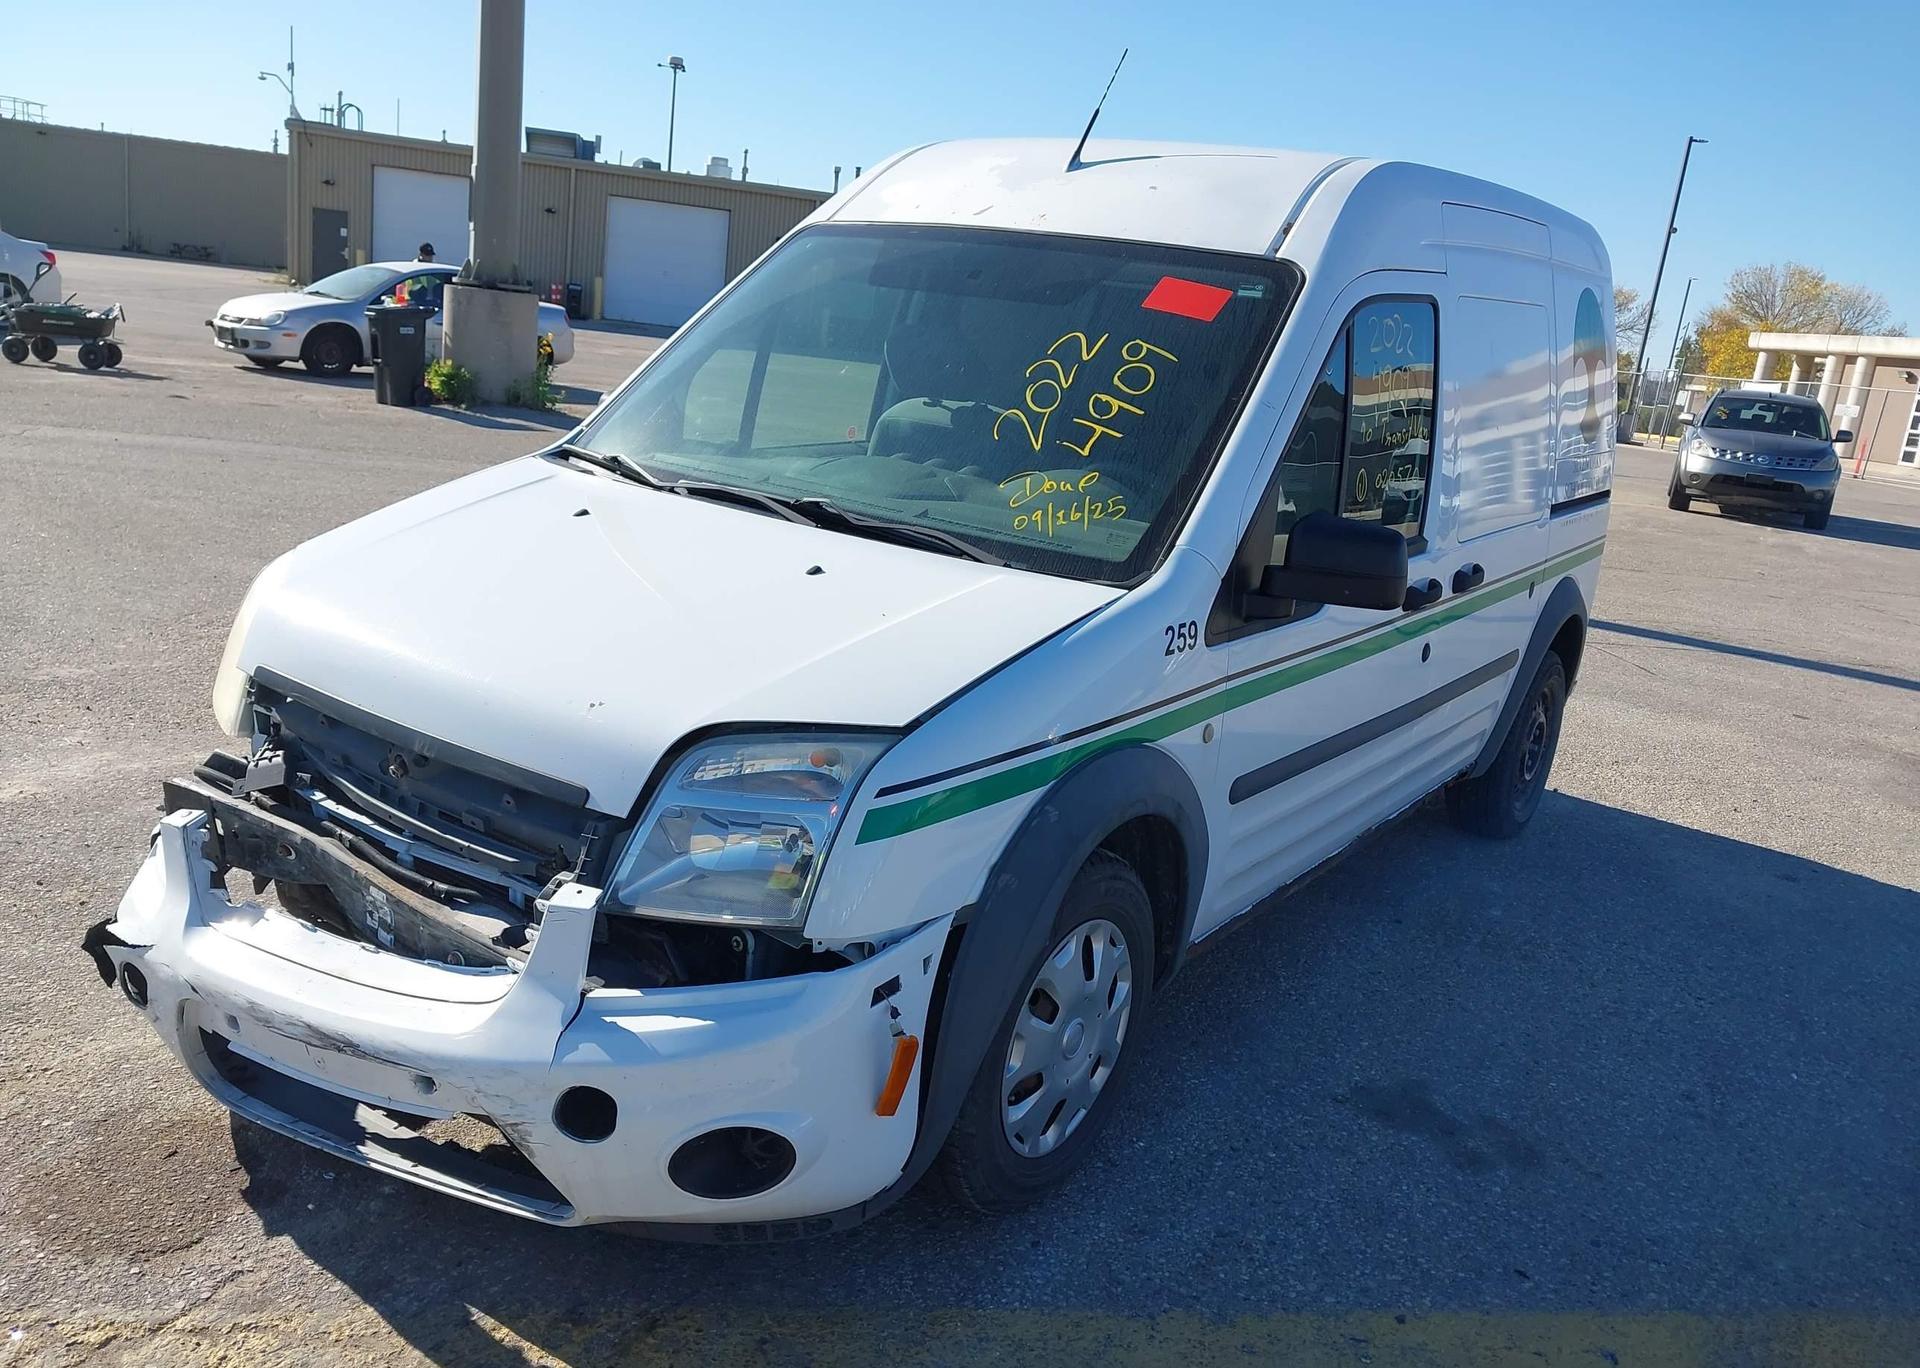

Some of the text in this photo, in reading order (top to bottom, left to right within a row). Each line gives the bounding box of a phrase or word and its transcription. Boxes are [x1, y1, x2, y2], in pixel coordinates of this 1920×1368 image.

[993, 331, 1110, 452] 2022
[1056, 339, 1179, 456] 4909
[1165, 620, 1198, 656] 259
